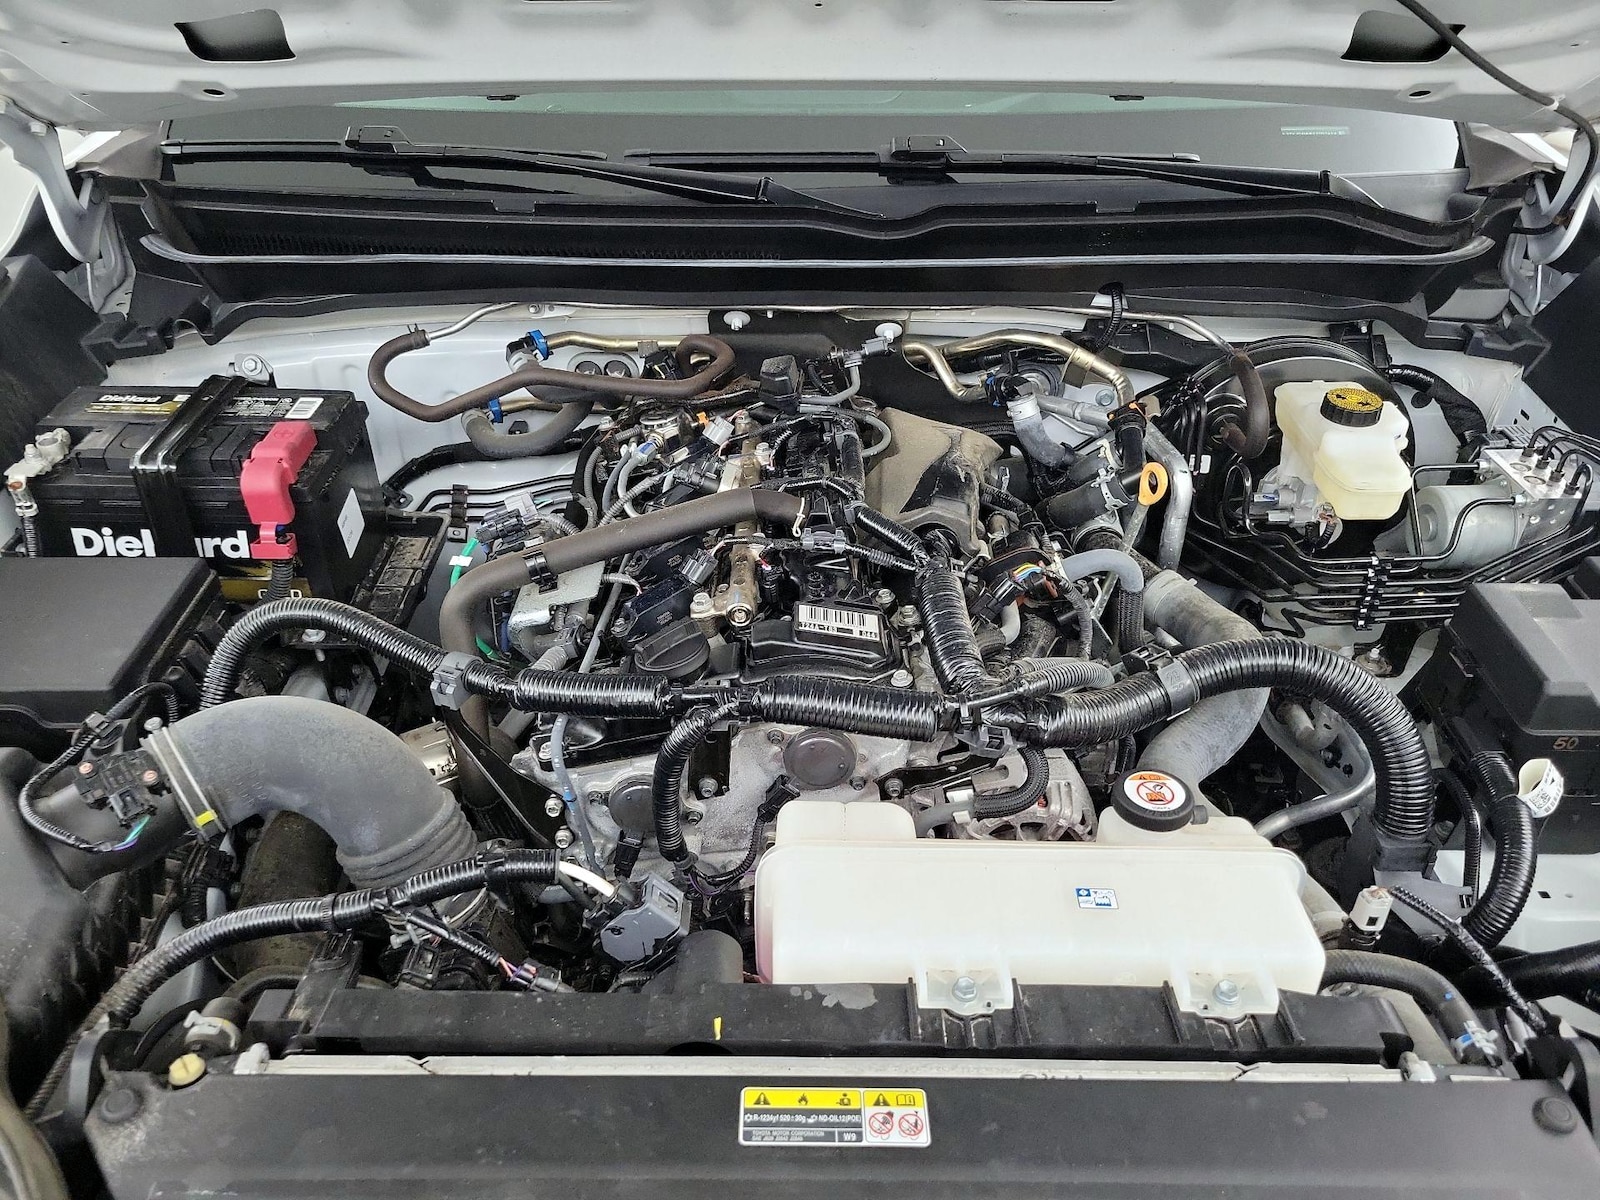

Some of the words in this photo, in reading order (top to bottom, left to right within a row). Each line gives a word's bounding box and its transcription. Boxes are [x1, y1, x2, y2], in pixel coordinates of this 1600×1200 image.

[98, 394, 162, 403] DieHard
[70, 526, 250, 558] Dierd
[1553, 737, 1579, 749] 50
[843, 1132, 857, 1142] W9
